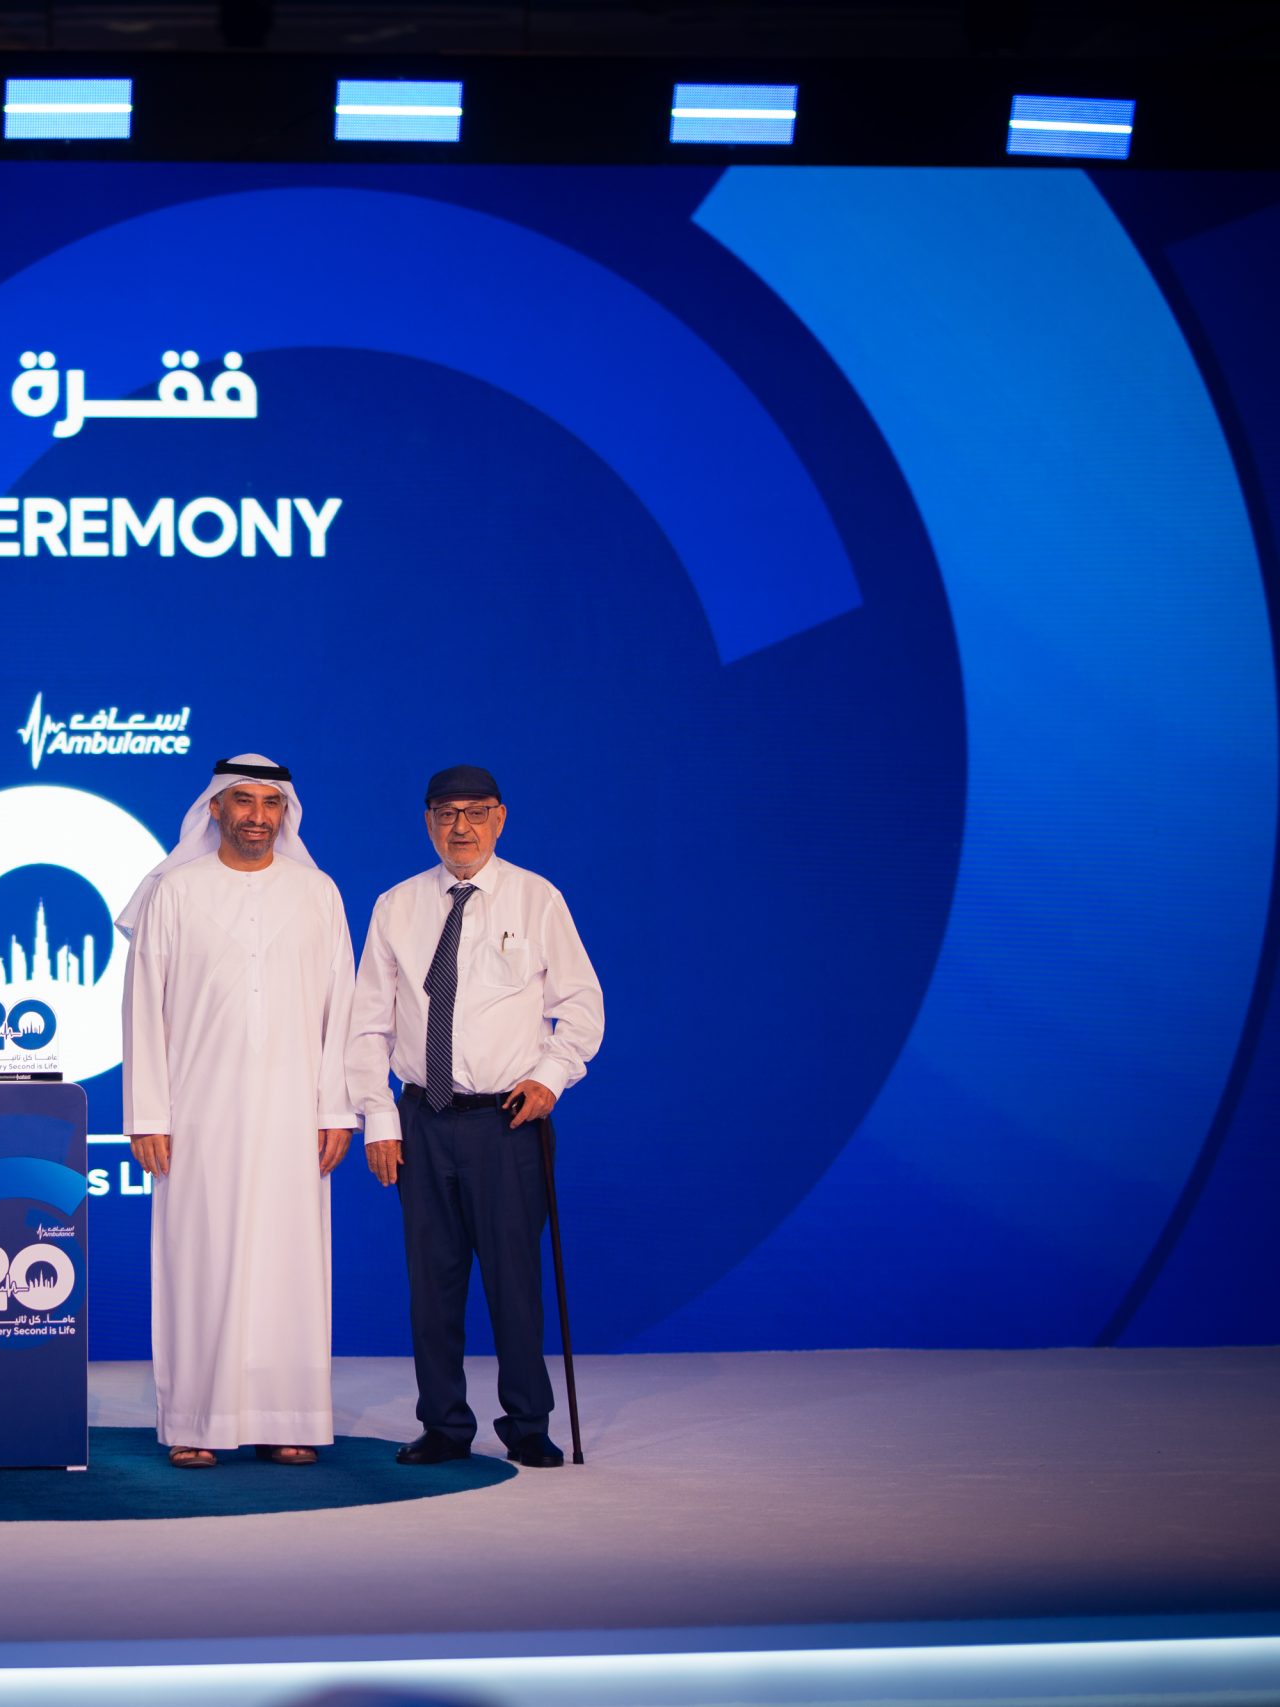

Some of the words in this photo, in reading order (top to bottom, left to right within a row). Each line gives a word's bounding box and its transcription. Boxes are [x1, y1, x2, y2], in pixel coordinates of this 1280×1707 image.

[11, 350, 259, 438] فقرة
[46, 730, 191, 755] Ambulance
[8, 1062, 36, 1070] Second
[36, 1062, 43, 1070] is
[44, 1062, 58, 1070] Life
[28, 1315, 41, 1326] كل
[13, 1326, 48, 1336] Second
[49, 1326, 57, 1335] is
[58, 1325, 76, 1335] Life
